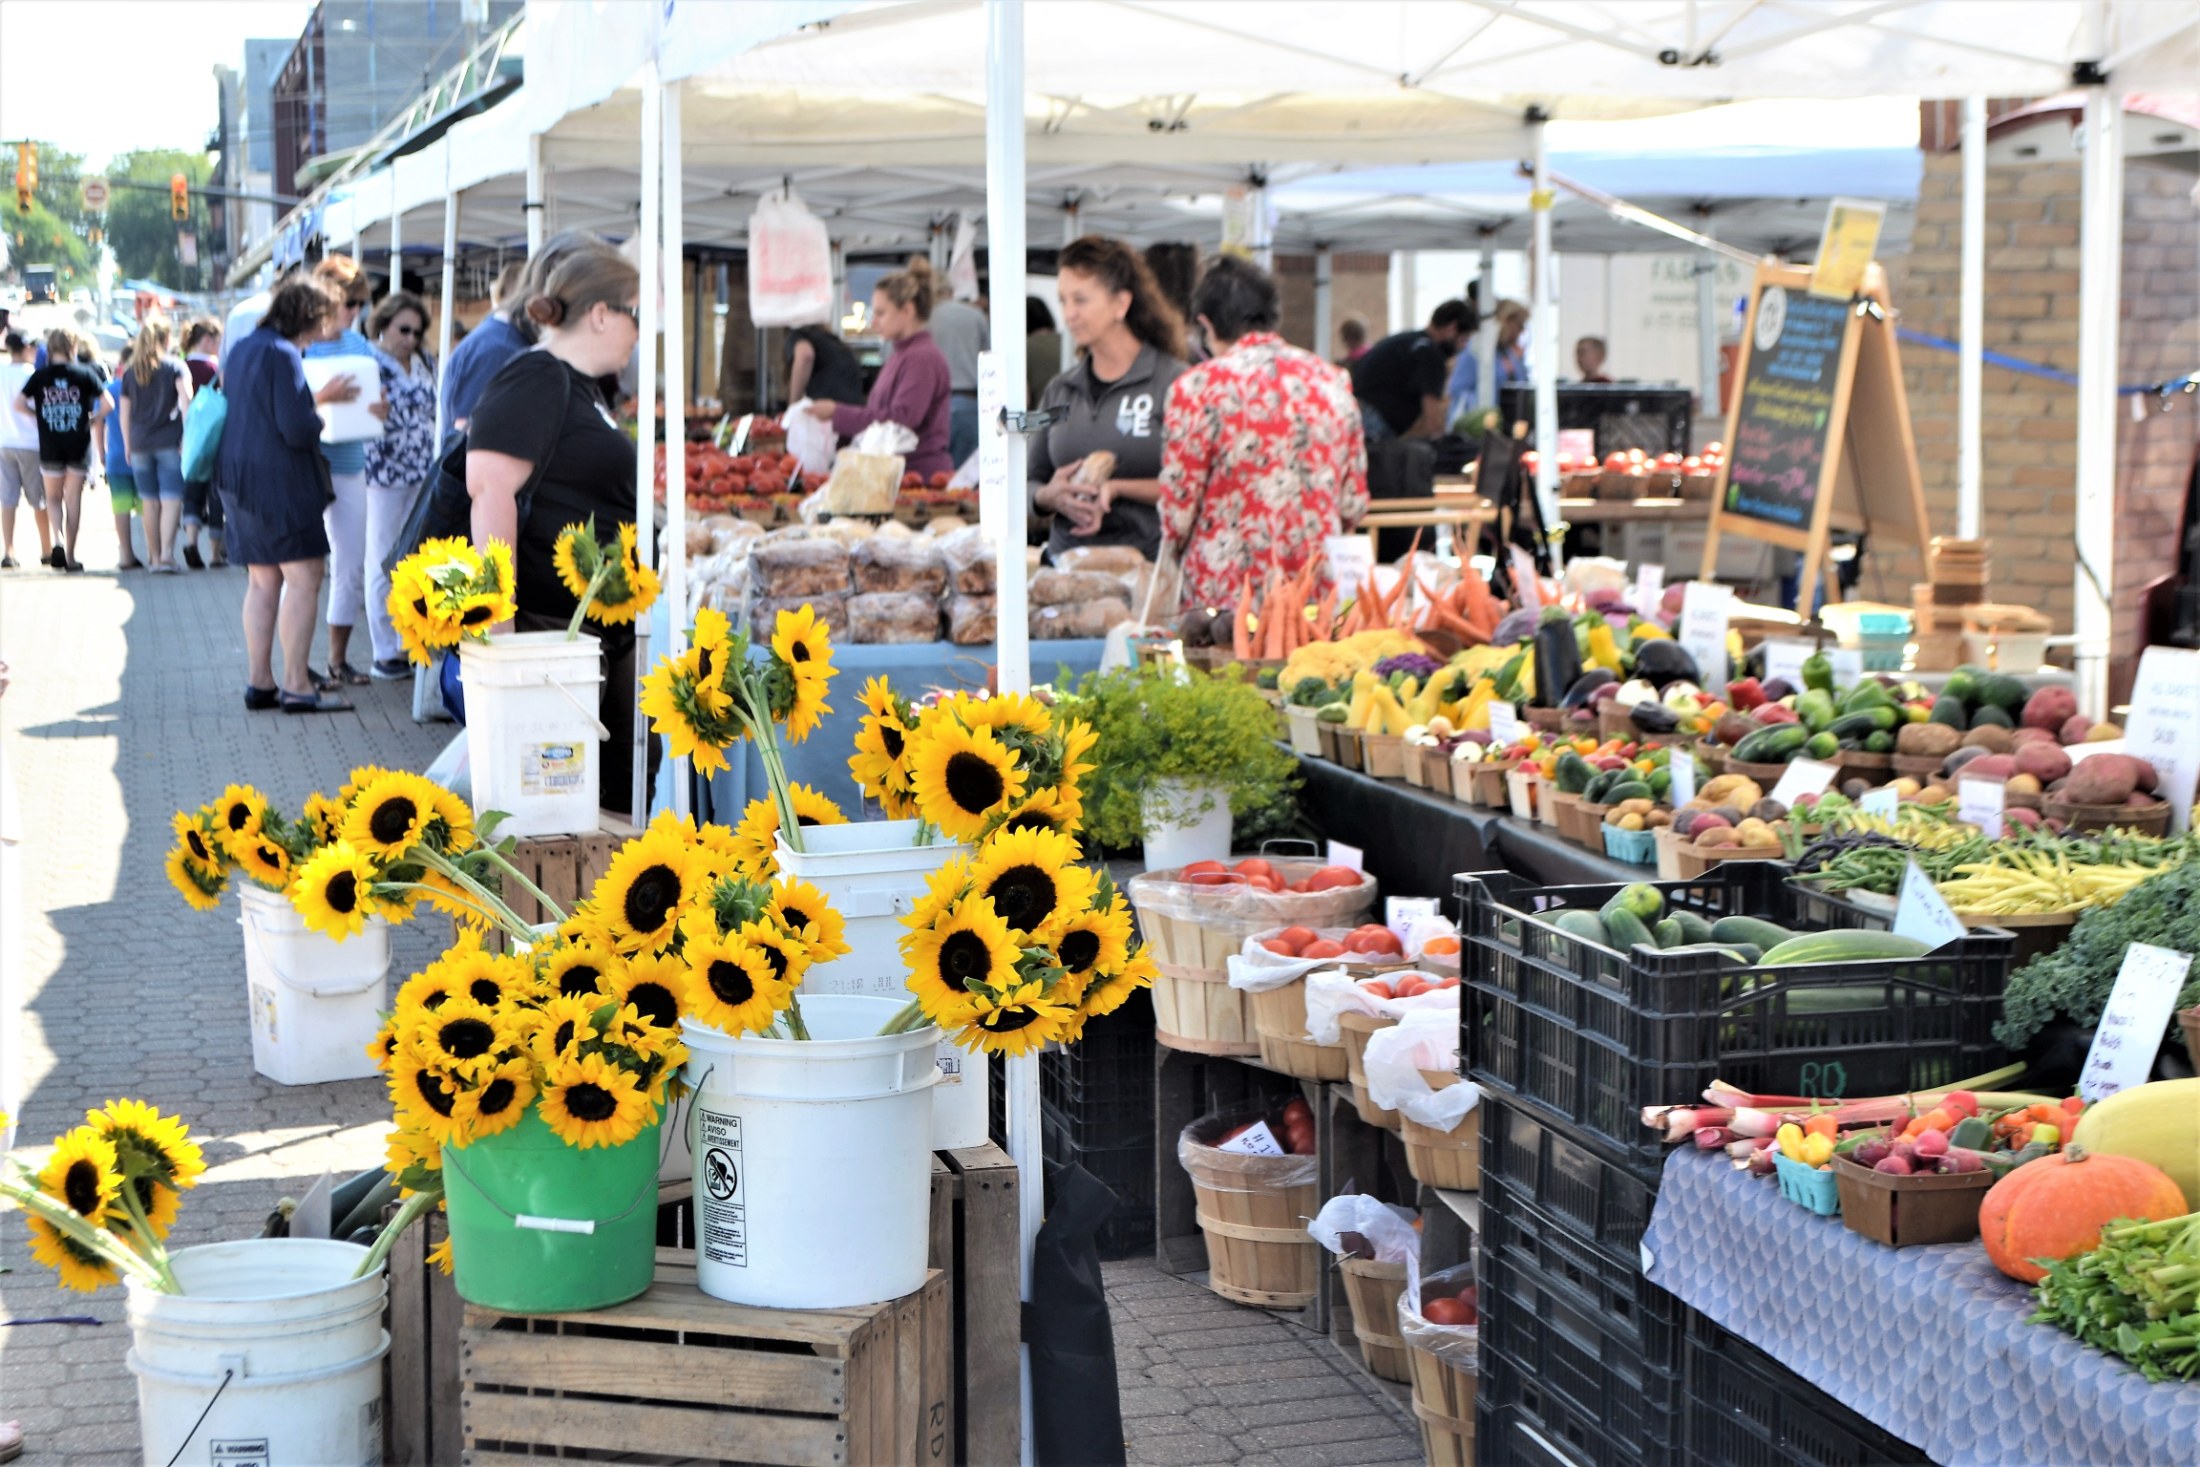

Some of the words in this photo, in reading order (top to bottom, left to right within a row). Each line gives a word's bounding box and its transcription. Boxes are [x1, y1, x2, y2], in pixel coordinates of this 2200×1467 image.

[1800, 1061, 1847, 1097] RD
[706, 1114, 737, 1127] WARNING
[707, 1125, 727, 1136] AVISO
[930, 1401, 945, 1459] RD
[226, 1444, 265, 1454] WARNING
